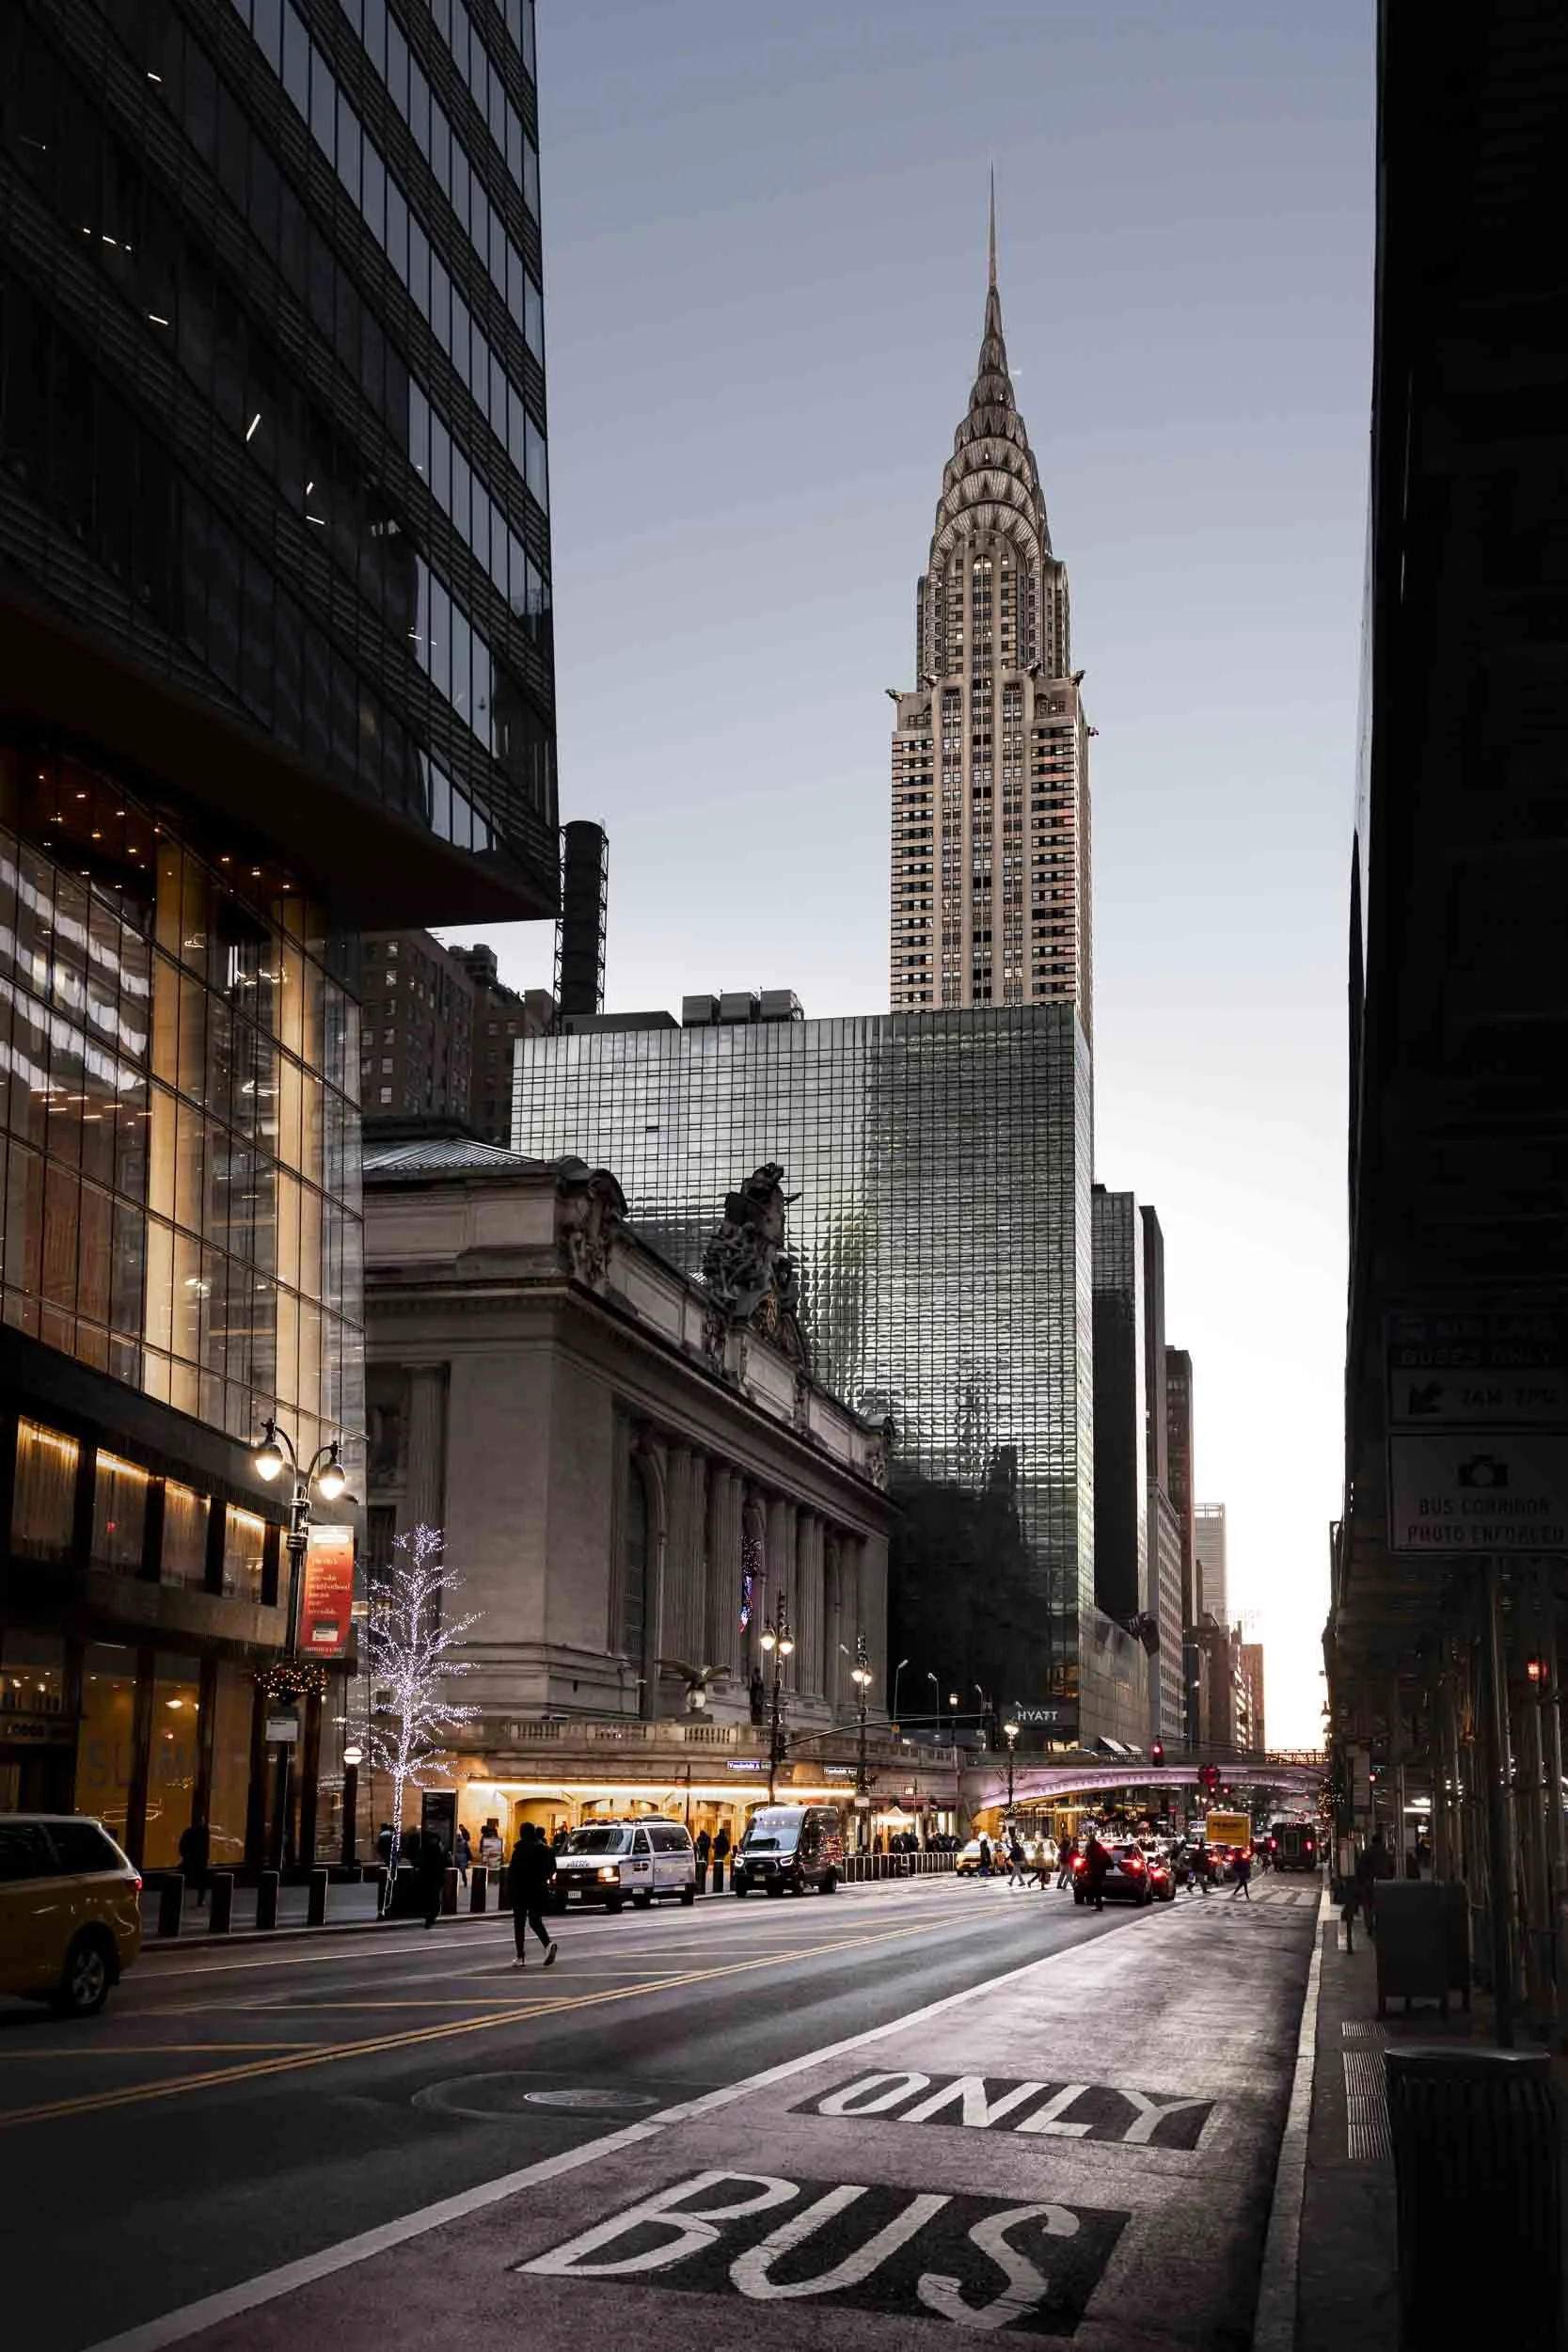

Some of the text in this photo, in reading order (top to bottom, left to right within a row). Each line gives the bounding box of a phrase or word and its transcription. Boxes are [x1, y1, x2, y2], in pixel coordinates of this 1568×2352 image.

[1491, 1346, 1554, 1366] ONLY
[1419, 1498, 1552, 1516] BUS CORRIDOR
[1408, 1525, 1565, 1543] PHOTO ENFORCED
[1017, 1710, 1058, 1721] HYATT
[816, 2072, 1207, 2145] ONLY
[514, 2169, 1079, 2330] BUS
